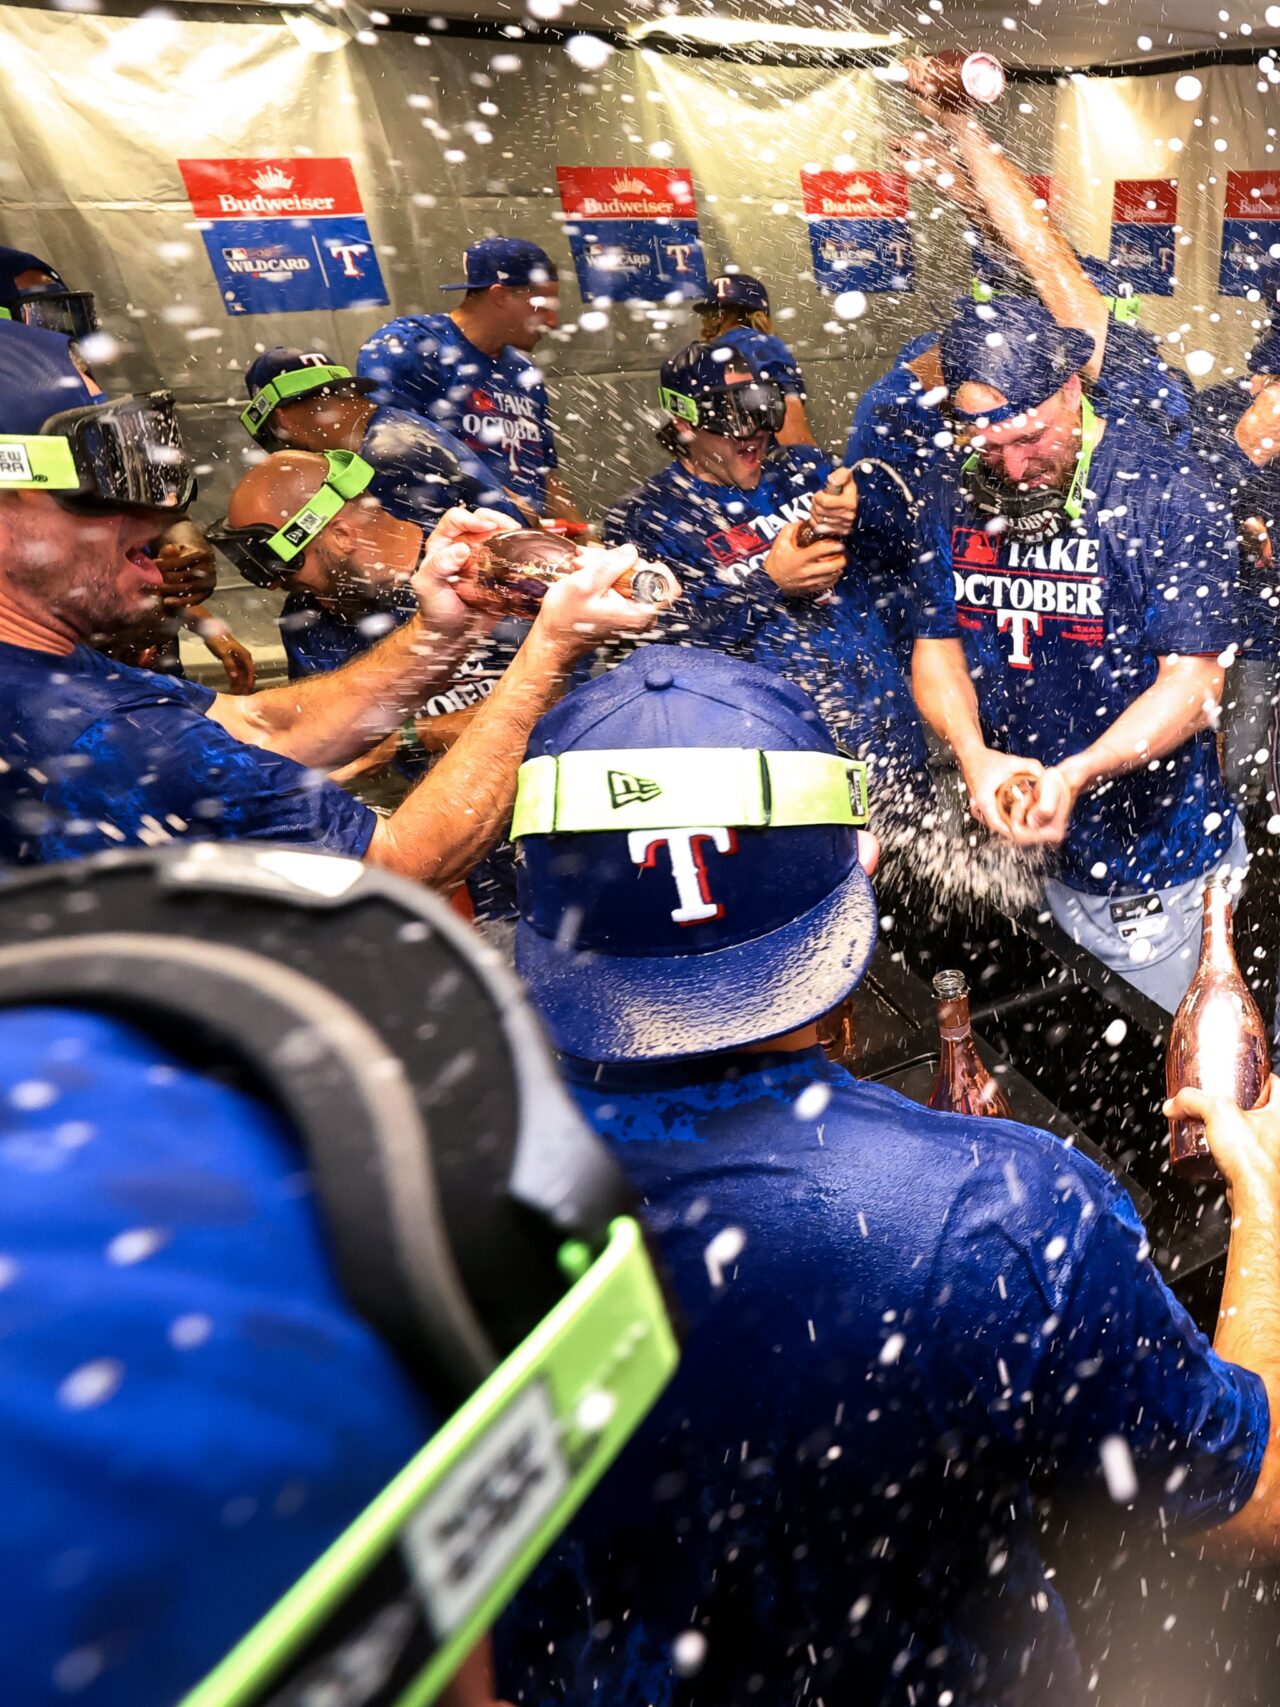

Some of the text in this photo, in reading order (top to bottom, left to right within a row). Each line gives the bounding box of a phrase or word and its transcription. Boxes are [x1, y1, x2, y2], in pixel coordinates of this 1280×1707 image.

[217, 194, 335, 212] Budweiser
[583, 198, 675, 214] Budweiser
[330, 244, 369, 278] T
[666, 244, 694, 273] T
[714, 277, 732, 298] T
[493, 391, 536, 418] TAKE
[0, 450, 21, 462] EW
[0, 461, 25, 473] RA
[1008, 538, 1100, 573] TAKE
[997, 608, 1043, 670] T
[627, 827, 740, 927] T
